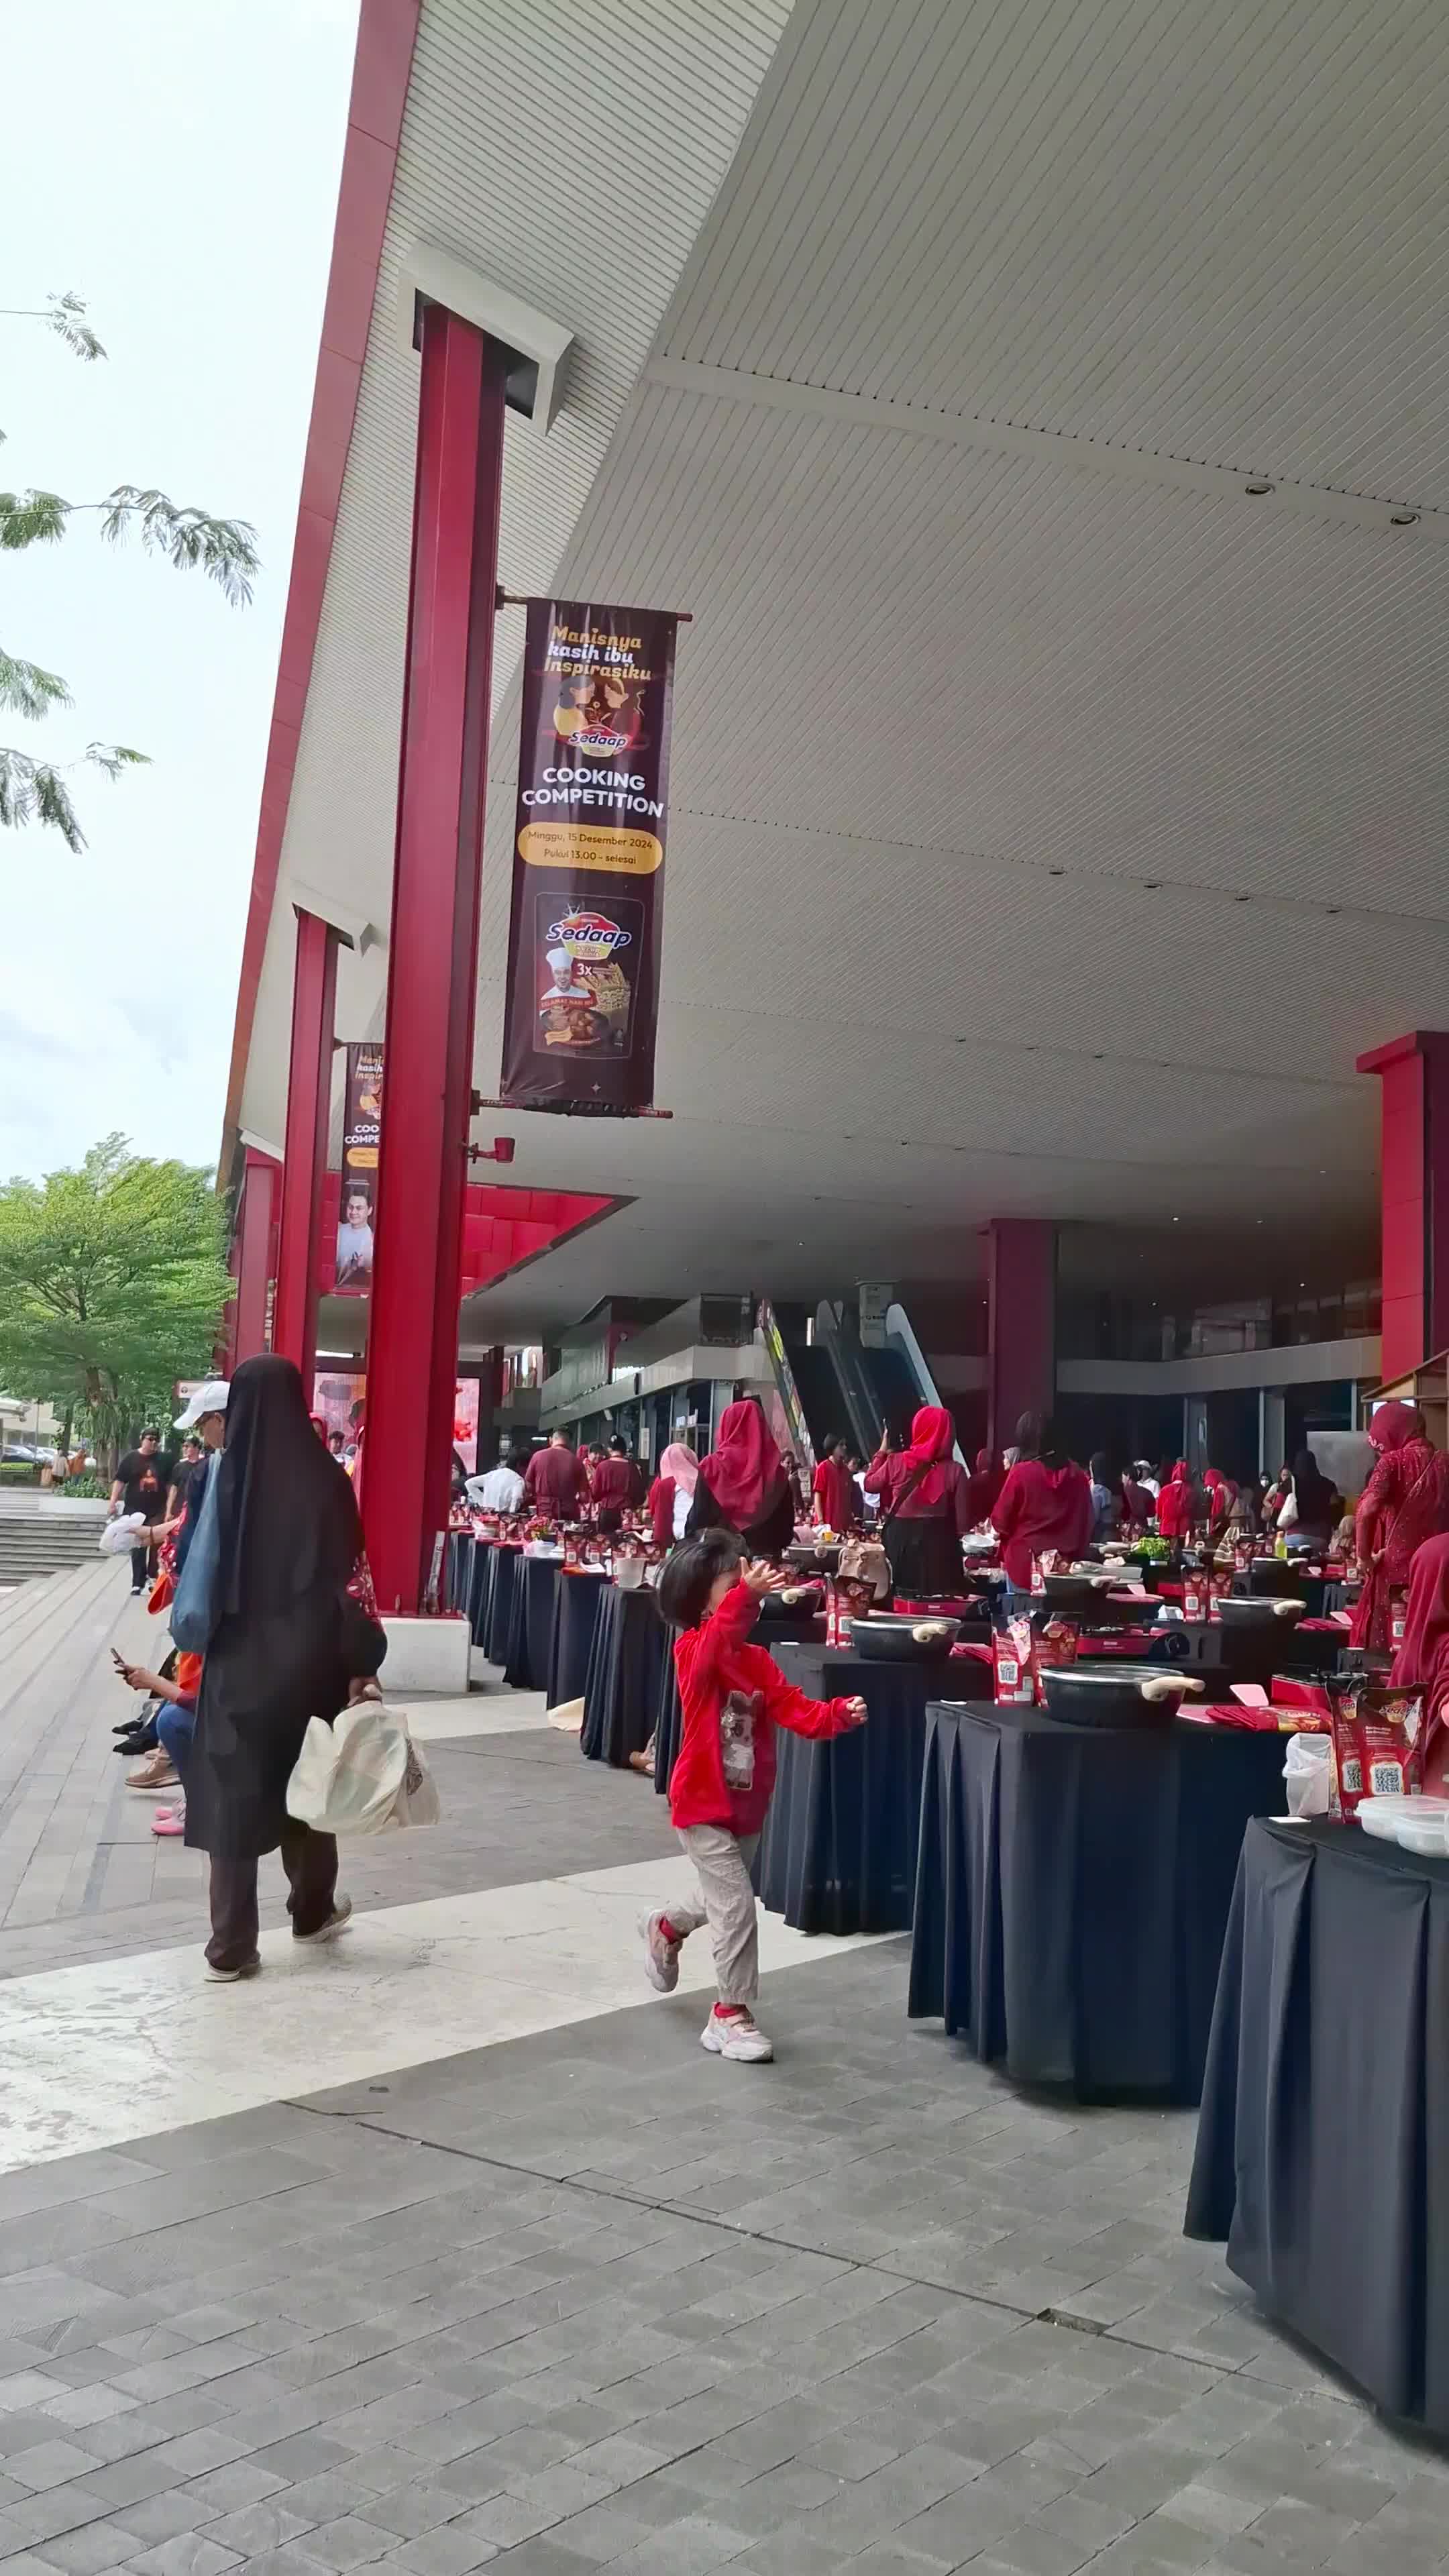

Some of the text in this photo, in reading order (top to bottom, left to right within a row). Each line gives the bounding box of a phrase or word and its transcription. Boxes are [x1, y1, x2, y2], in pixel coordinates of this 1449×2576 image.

[552, 625, 642, 652] Manisnya
[547, 641, 634, 663] kasih ibu
[543, 656, 651, 680] Inspirasiku
[570, 731, 627, 749] Sedaap
[542, 767, 646, 790] COOKING
[521, 788, 665, 818] COMPETITION
[527, 831, 653, 849] Minggu, 15 Desember 2024
[543, 848, 570, 858] Pukul
[571, 849, 597, 861] 13.00
[605, 855, 637, 865] selesai
[546, 922, 632, 950] Sedaap
[577, 963, 593, 976] 3x
[354, 1124, 380, 1133] COO
[344, 1135, 380, 1144] COMPE
